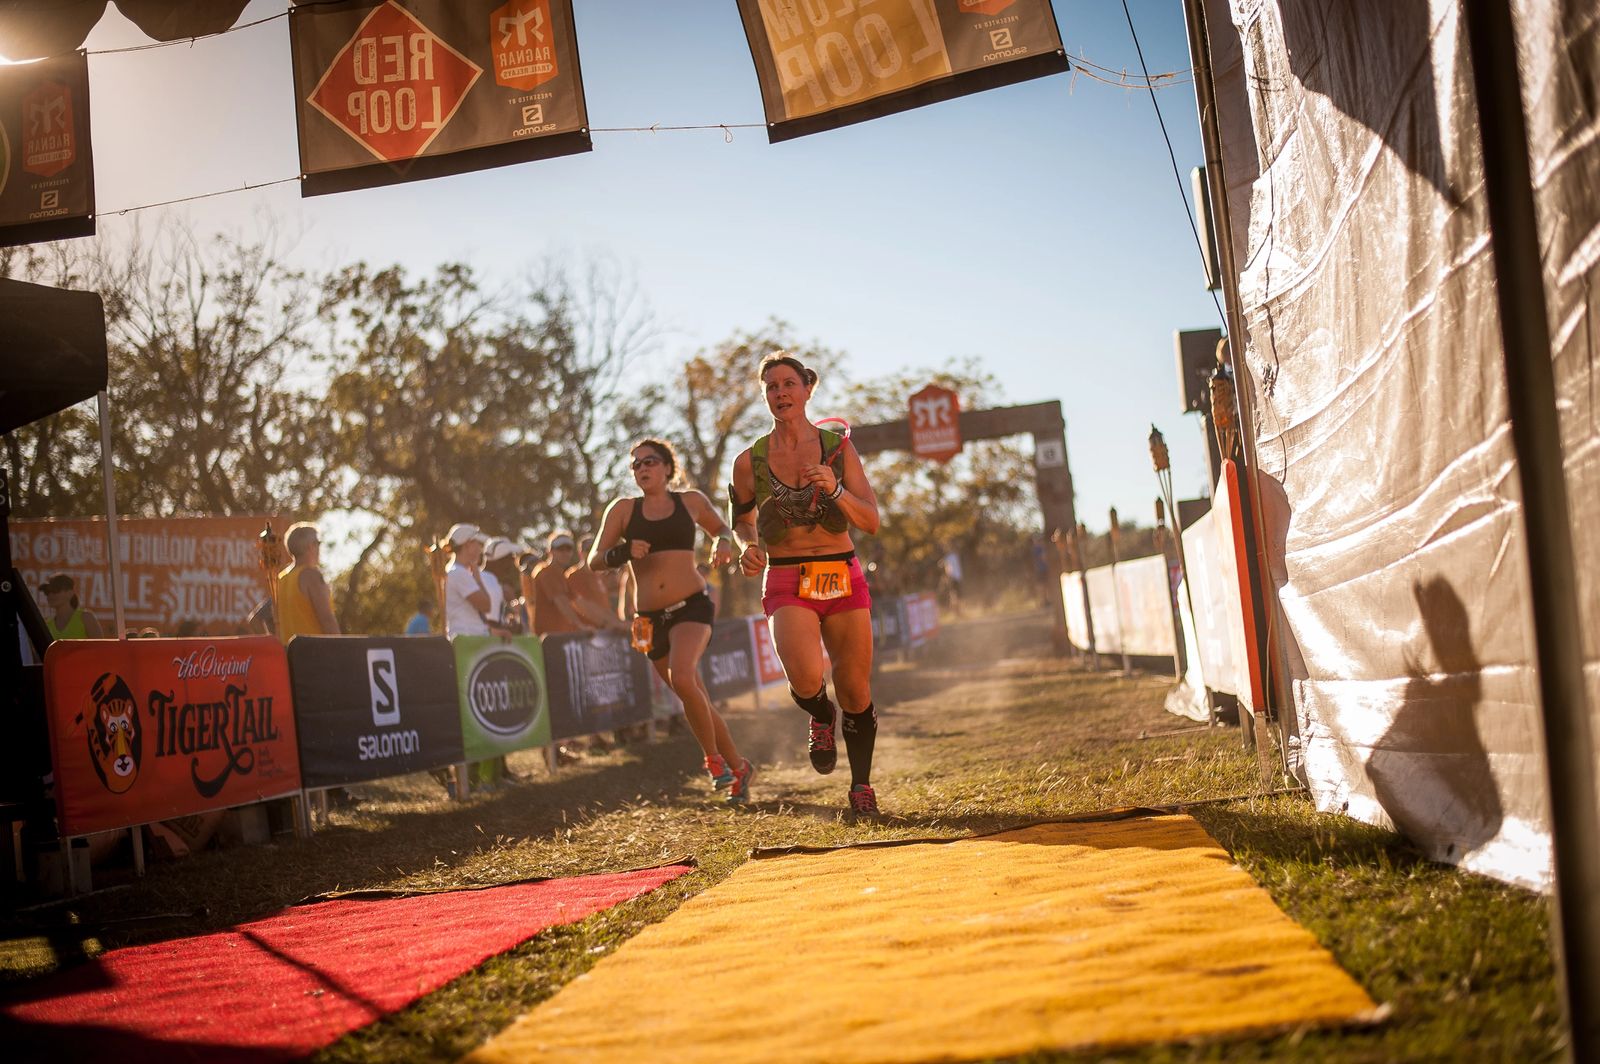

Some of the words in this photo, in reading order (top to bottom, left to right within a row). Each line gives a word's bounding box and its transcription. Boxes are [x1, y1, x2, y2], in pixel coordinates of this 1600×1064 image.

[815, 572, 840, 595] 176
[199, 645, 252, 681] Original
[358, 729, 420, 761] salomon
